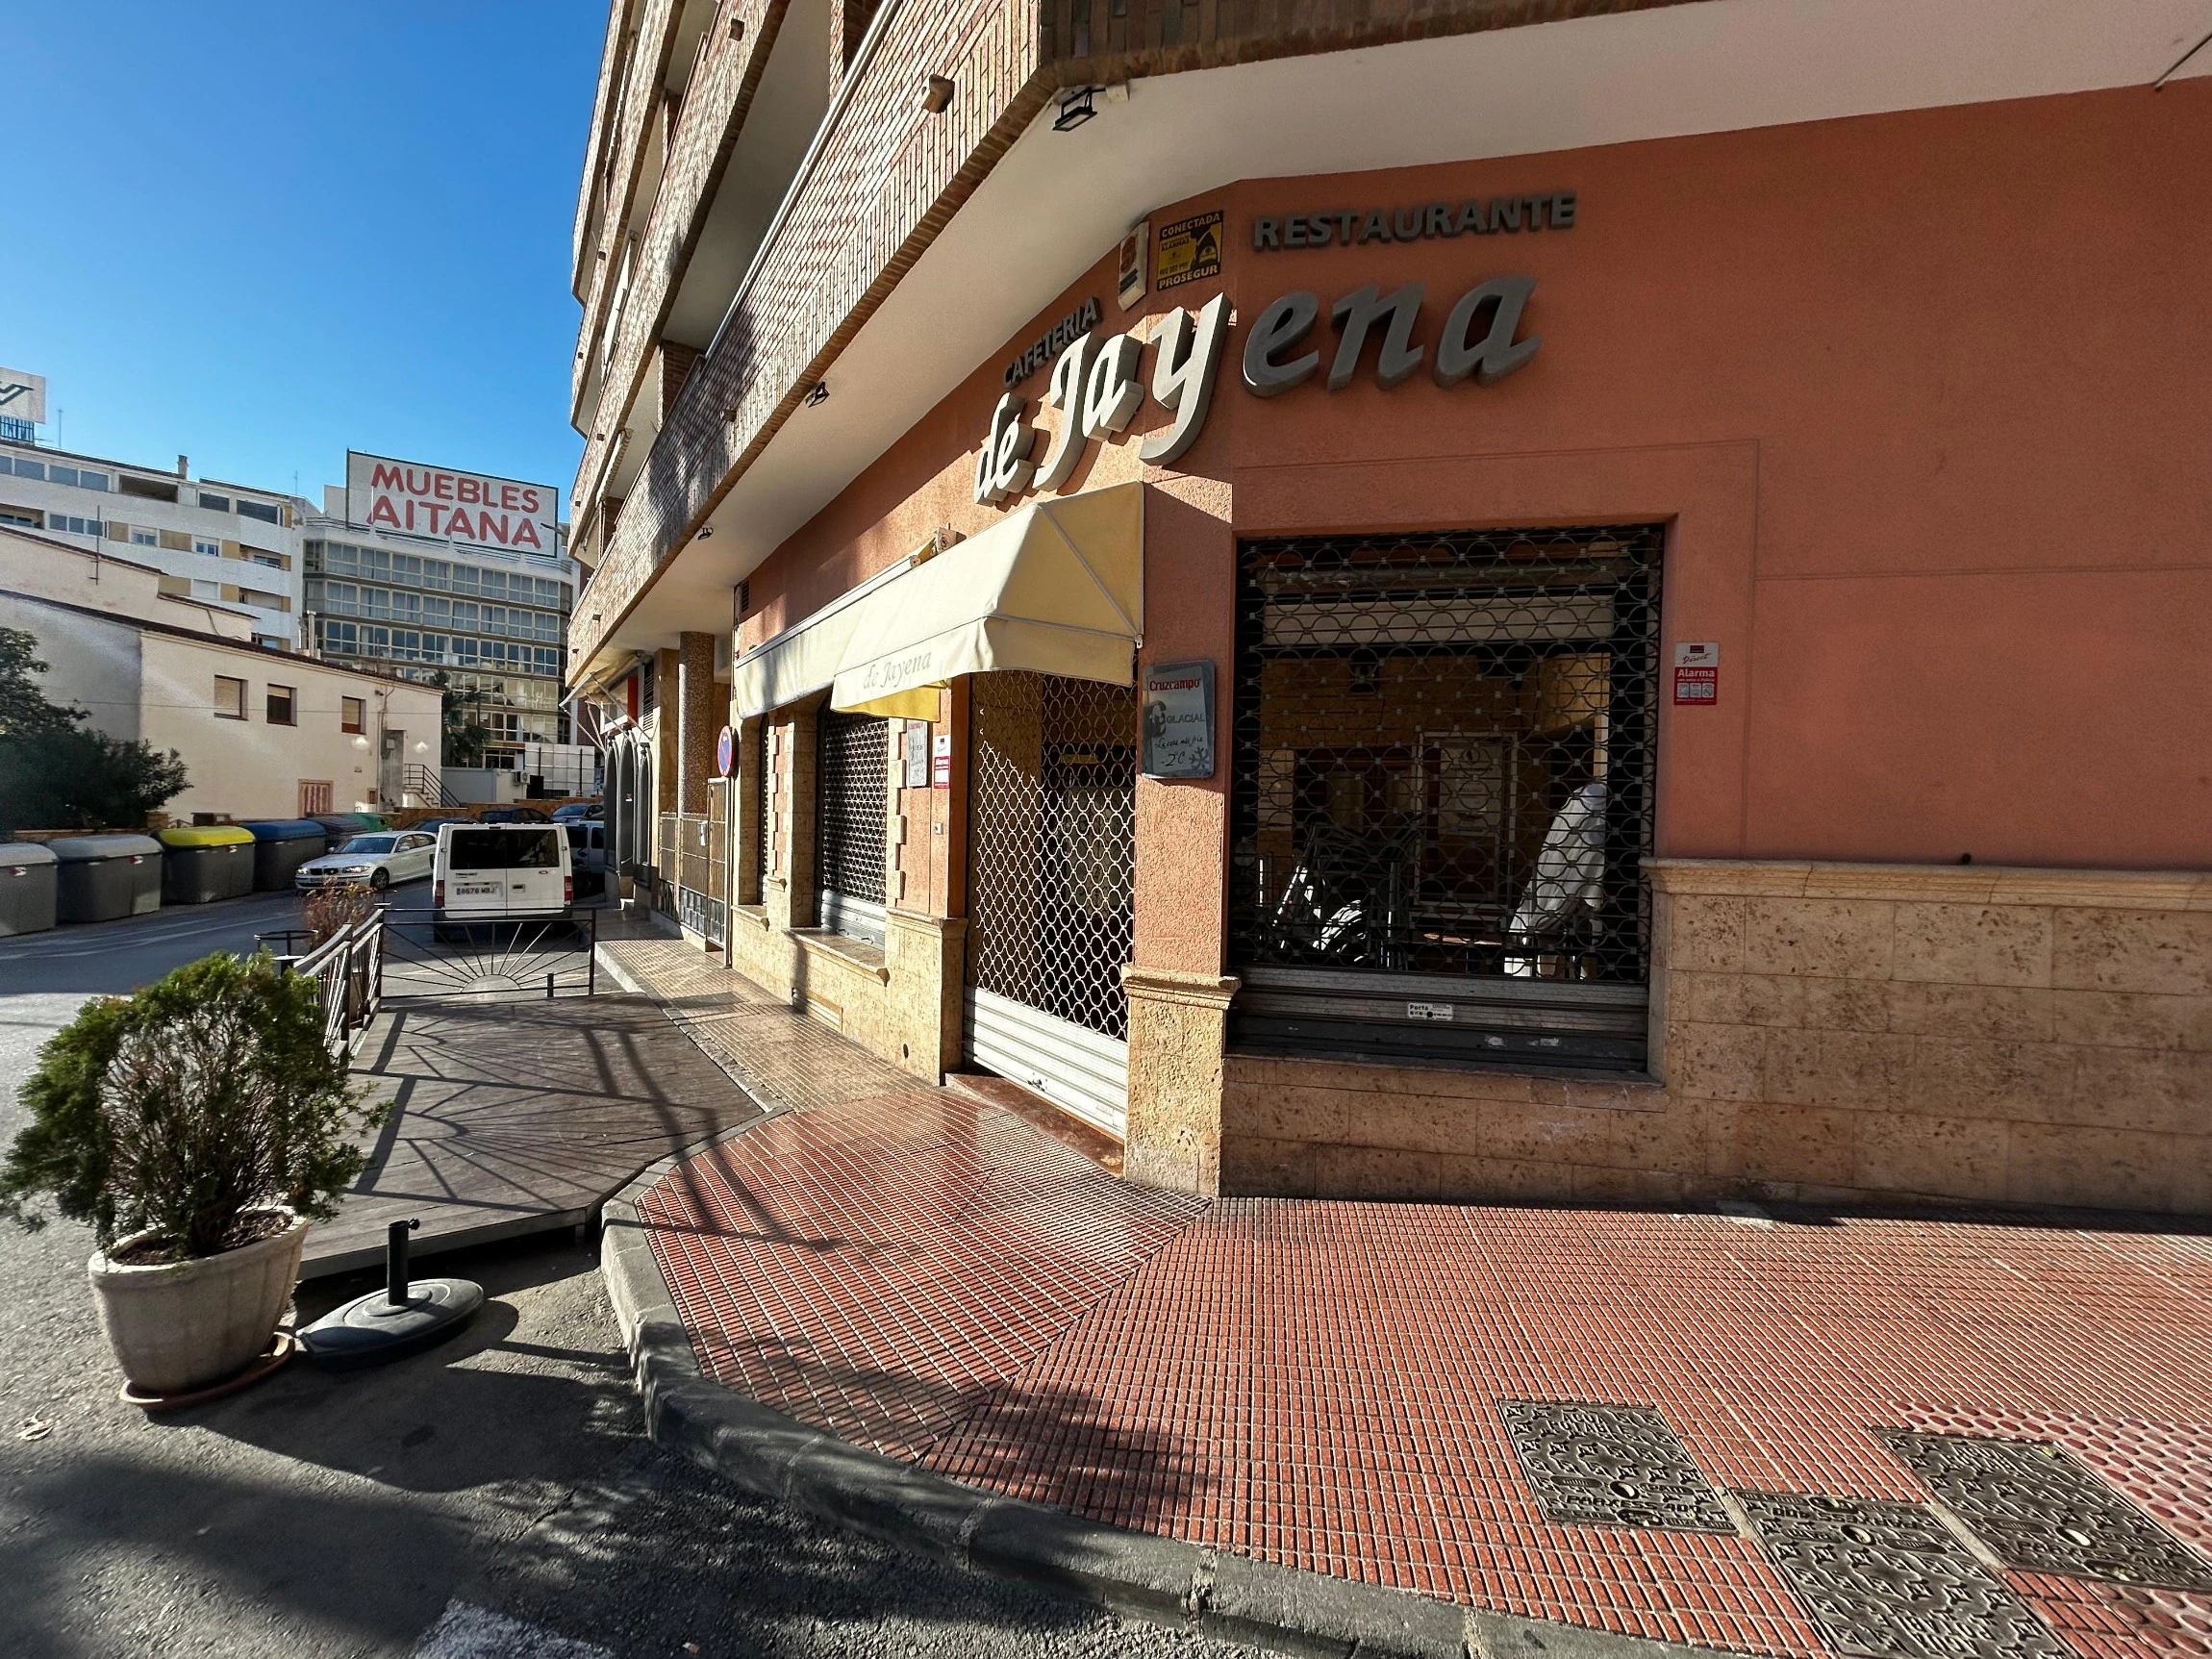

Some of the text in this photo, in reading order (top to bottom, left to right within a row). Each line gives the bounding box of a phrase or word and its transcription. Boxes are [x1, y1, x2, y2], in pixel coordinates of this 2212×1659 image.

[1162, 213, 1220, 238] CONECTADA
[1253, 192, 1575, 252] RESTAURANTE
[1159, 264, 1219, 289] PROSEGUR
[1004, 296, 1103, 388] CAFETERIA
[973, 275, 1543, 507] de Jayena
[371, 464, 540, 513] MUEBLES
[366, 495, 541, 549] AITANA
[864, 651, 932, 690] de Jayena
[1677, 668, 1715, 677] Alarma
[1149, 678, 1200, 691] Cruzcampo
[1166, 714, 1205, 724] GLACIAL
[1546, 1420, 1632, 1434] POTABLE
[1562, 1413, 1607, 1424] AGUA
[1564, 1495, 1660, 1511] PARXESS
